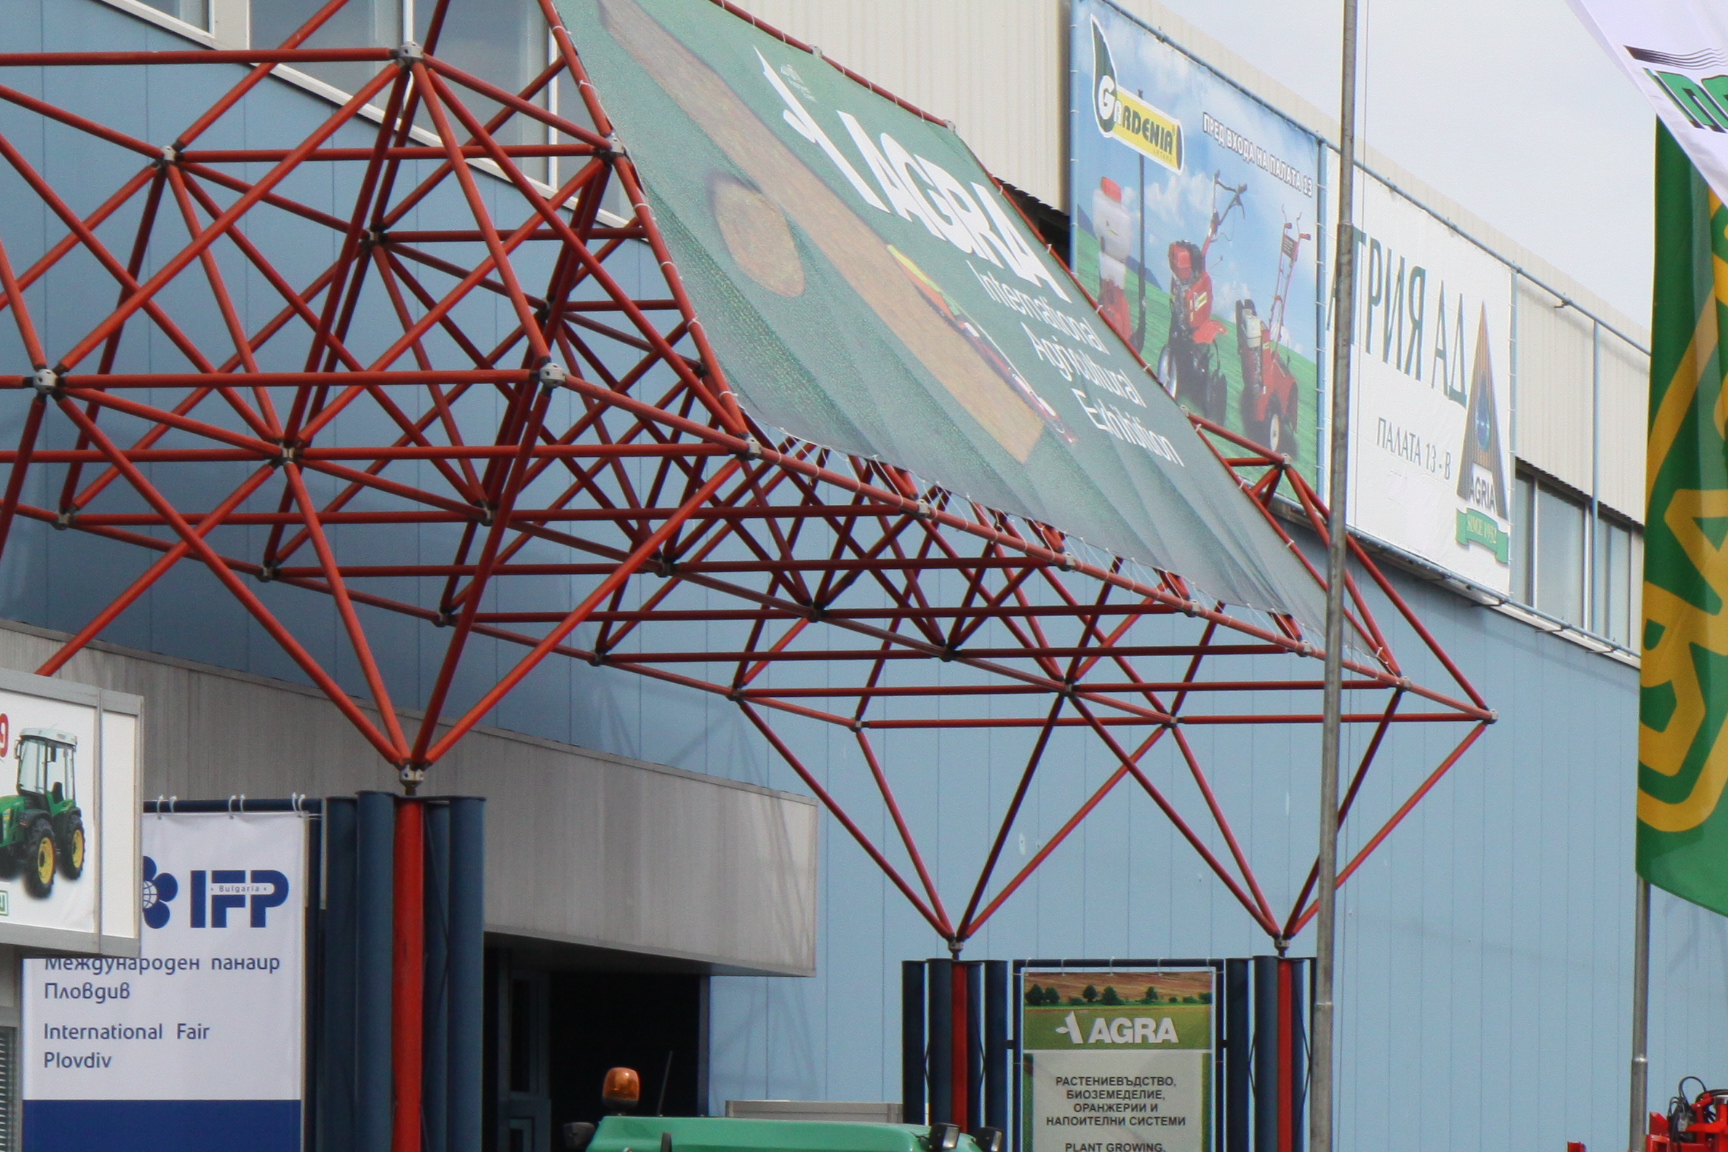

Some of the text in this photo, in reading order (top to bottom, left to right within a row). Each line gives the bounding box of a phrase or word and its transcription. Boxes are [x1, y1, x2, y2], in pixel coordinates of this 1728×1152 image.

[1098, 75, 1173, 155] GARDENIA
[1203, 111, 1313, 198] ПРЕД ВХОДА НА ПАЛАТА 13
[837, 110, 1072, 303] AGRA
[965, 260, 1110, 355] International
[1431, 279, 1467, 409] АД
[1020, 321, 1147, 408] Agricultural
[1071, 388, 1184, 467] Exhibition
[1377, 416, 1422, 467] ПАЛАТА
[1426, 442, 1437, 473] 13
[1469, 476, 1497, 516] AGRIA
[190, 869, 289, 928] IFP
[218, 884, 261, 894] Bulgaria
[44, 957, 280, 975] Международен панаир
[44, 982, 130, 1004] Пловдив
[44, 1023, 210, 1040] International Fair
[1088, 1017, 1179, 1044] AGRA
[44, 1052, 112, 1068] Plovdiv
[1055, 1076, 1177, 1087] РАСТЕНИЕВЪДСТВО,
[1066, 1089, 1166, 1101] БИОЗЕМЕДЕЛИЕ,
[1046, 1116, 1186, 1126] НАПОИТЕЛНИ СИСТЕМИ
[1073, 1103, 1158, 1113] ОРАНЖЕРИИ И
[1065, 1143, 1103, 1152] PLANT
